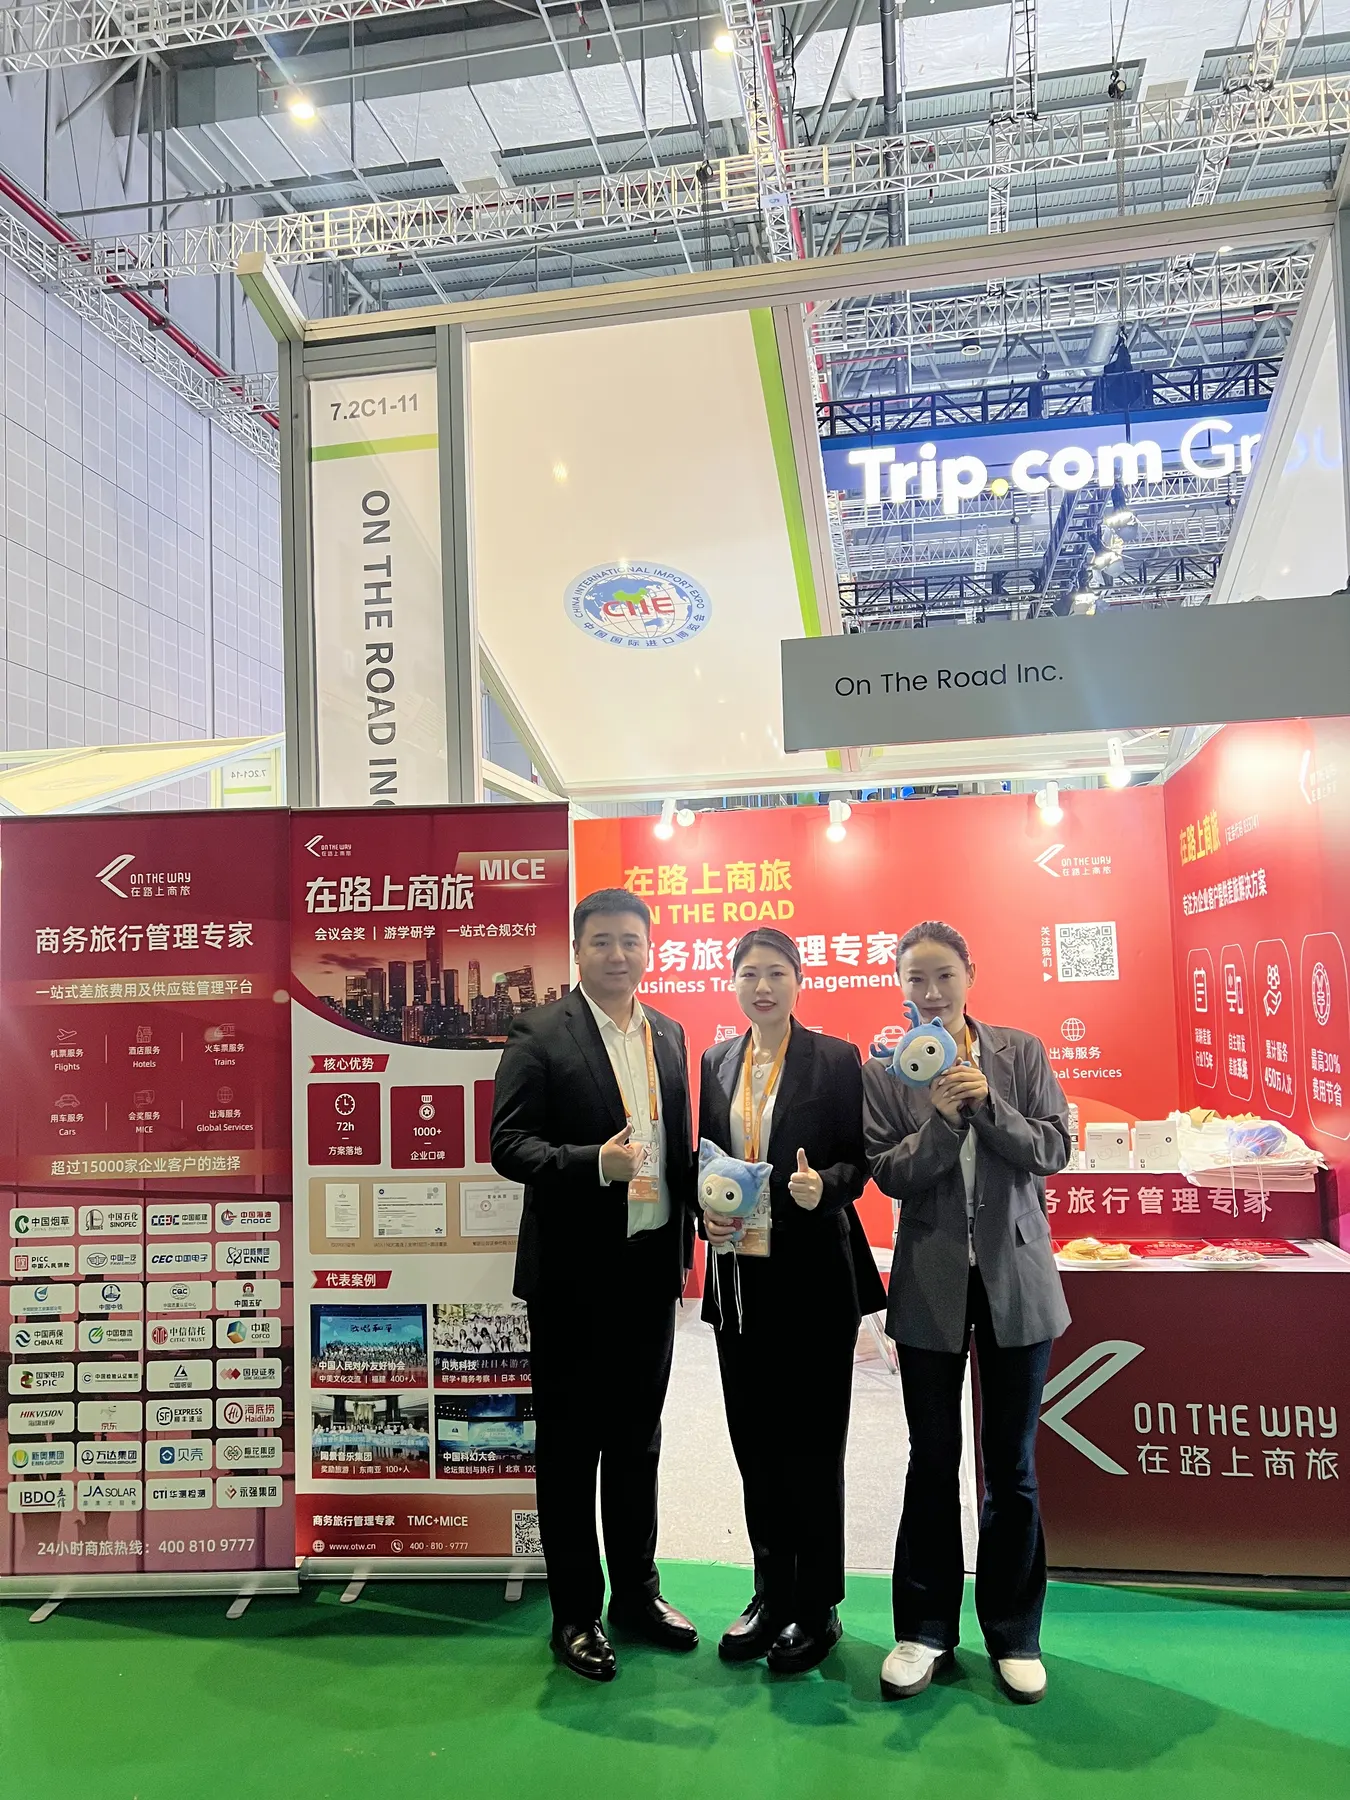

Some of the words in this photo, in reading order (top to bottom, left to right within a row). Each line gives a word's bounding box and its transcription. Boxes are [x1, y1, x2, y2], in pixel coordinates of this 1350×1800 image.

[330, 393, 418, 421] 7.2C1-11
[848, 438, 1163, 515] Trip.com
[362, 490, 391, 544] ON
[574, 566, 650, 596] INTERNATIONAL
[654, 569, 693, 590] IMPORT
[364, 554, 393, 630] THE
[689, 590, 705, 609] EXPO
[572, 596, 583, 618] CHINA
[602, 597, 675, 617] CIIE
[835, 675, 871, 697] On
[881, 669, 928, 695] The
[938, 664, 1007, 691] Road
[1017, 662, 1064, 684] Inc.
[365, 642, 397, 745] ROAD
[369, 758, 398, 805] IN
[1179, 808, 1221, 867] 在路上商旅
[1061, 857, 1072, 866] ON
[1073, 857, 1090, 866] THE
[1091, 856, 1112, 865] WAY
[480, 858, 546, 881] MICE
[130, 873, 144, 884] ON
[146, 873, 164, 884] THE
[166, 872, 191, 884] WAY
[624, 859, 792, 896] 在路上商旅
[131, 885, 191, 897] 在路上商旅
[305, 874, 474, 913] 在路上商旅
[668, 903, 715, 924] THE
[723, 900, 794, 922] ROAD
[314, 927, 366, 941] 会议会奖
[384, 925, 436, 940] 游学研学
[447, 923, 537, 938] 一站式合规交付
[35, 921, 254, 955] 商务旅行管理专家
[1041, 926, 1053, 967] 关注我们
[637, 977, 706, 994] usiness
[710, 977, 736, 992] Tra
[801, 972, 901, 992] nagement
[36, 980, 253, 1000] 一站式差旅费用及供应链管理平台
[50, 1048, 84, 1058] 机票服务
[128, 1046, 160, 1056] 酒店服务
[204, 1043, 245, 1053] 火车票服务
[1049, 1046, 1101, 1060] 出海服务
[1265, 1040, 1288, 1063] 累计服务
[54, 1061, 81, 1072] Flights
[132, 1060, 156, 1069] Hotels
[214, 1057, 236, 1067] Trains
[323, 1058, 374, 1071] 核心优势
[1311, 1048, 1341, 1074] 最高30%
[1072, 1068, 1122, 1079] Services
[1265, 1067, 1293, 1095] 450万人次
[1312, 1077, 1343, 1107] 费用节省
[50, 1113, 85, 1123] 用车服务
[128, 1111, 160, 1121] 会奖服务
[209, 1109, 242, 1119] 出海服务
[58, 1127, 77, 1137] Cars
[135, 1125, 153, 1133] MICE
[196, 1123, 221, 1132] Global
[223, 1122, 254, 1131] Services
[336, 1122, 355, 1131] 72h
[413, 1127, 442, 1137] 1000+
[328, 1146, 363, 1156] 方案落地
[410, 1151, 446, 1161] 企业口碑
[51, 1156, 241, 1177] 超过15000家企业客户的选择
[1046, 1187, 1273, 1215] 务旅行管理专家
[31, 1216, 70, 1227] 中国烟草
[108, 1212, 139, 1222] 中国石化
[152, 1255, 174, 1264] CEC
[174, 1254, 208, 1263] 中国电子
[244, 1255, 270, 1264] CNNC
[326, 1273, 376, 1287] 代表案例
[234, 1300, 262, 1308] 中国五矿
[169, 1326, 206, 1336] 中信信托
[251, 1323, 270, 1332] 中粮
[34, 1330, 64, 1338] 中国再保
[318, 1361, 406, 1371] 中国人民对外友好协会
[243, 1368, 275, 1376] 国投证券
[390, 1375, 416, 1383] 400+人
[501, 1374, 515, 1382] 日本
[20, 1410, 64, 1418] HIKVISION
[159, 1411, 170, 1421] SF
[174, 1408, 203, 1416] EXPRESS
[245, 1404, 275, 1415] 海底捞
[245, 1415, 275, 1423] Haidilao
[1134, 1402, 1176, 1435] ON
[1185, 1404, 1250, 1436] THE
[1259, 1405, 1337, 1439] WAY
[101, 1422, 117, 1430] 京东
[96, 1451, 137, 1460] 万达集团
[178, 1448, 203, 1462] 贝壳
[443, 1451, 497, 1462] 中国科幻大会
[1136, 1442, 1339, 1480] 在路上商旅
[359, 1465, 381, 1474] 东南亚
[385, 1465, 410, 1473] 100+人
[444, 1465, 495, 1475] 论坛策划与执行
[505, 1465, 520, 1473] 北京
[83, 1486, 104, 1497] JA
[105, 1488, 136, 1497] SOLAR
[153, 1490, 168, 1499] CTI
[169, 1489, 206, 1498] 华测检测
[240, 1486, 277, 1497] 永强集团
[24, 1491, 55, 1503] BDO
[57, 1488, 66, 1508] 立信
[312, 1515, 395, 1527] 商务旅行管理专家
[407, 1515, 468, 1527] TMC+MICE
[158, 1541, 184, 1553] 400
[189, 1540, 216, 1552] 810
[220, 1539, 255, 1552] 9777
[329, 1542, 376, 1550] www.otw.cn
[410, 1542, 424, 1550] 400
[431, 1542, 443, 1550] 810
[449, 1542, 468, 1550] 9777
